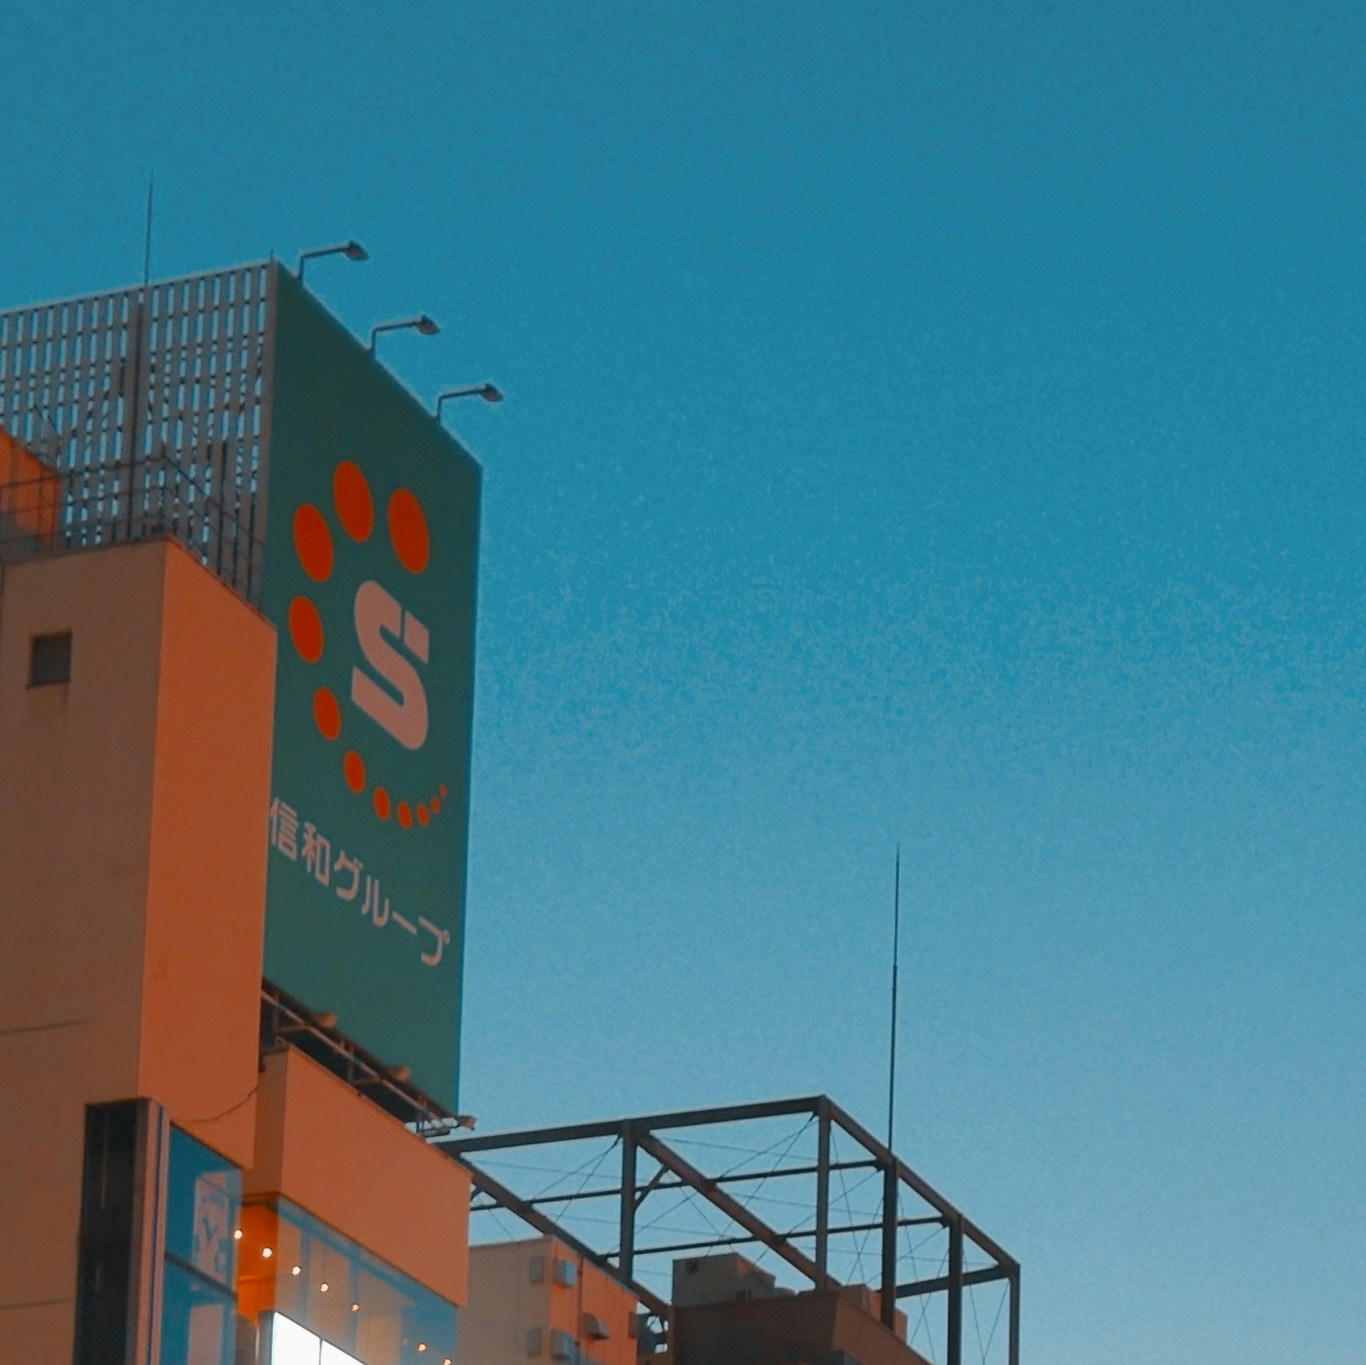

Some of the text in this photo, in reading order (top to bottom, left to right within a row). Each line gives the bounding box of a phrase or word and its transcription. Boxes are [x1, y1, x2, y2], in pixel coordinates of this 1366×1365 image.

[269, 797, 452, 969] 信和グループ
